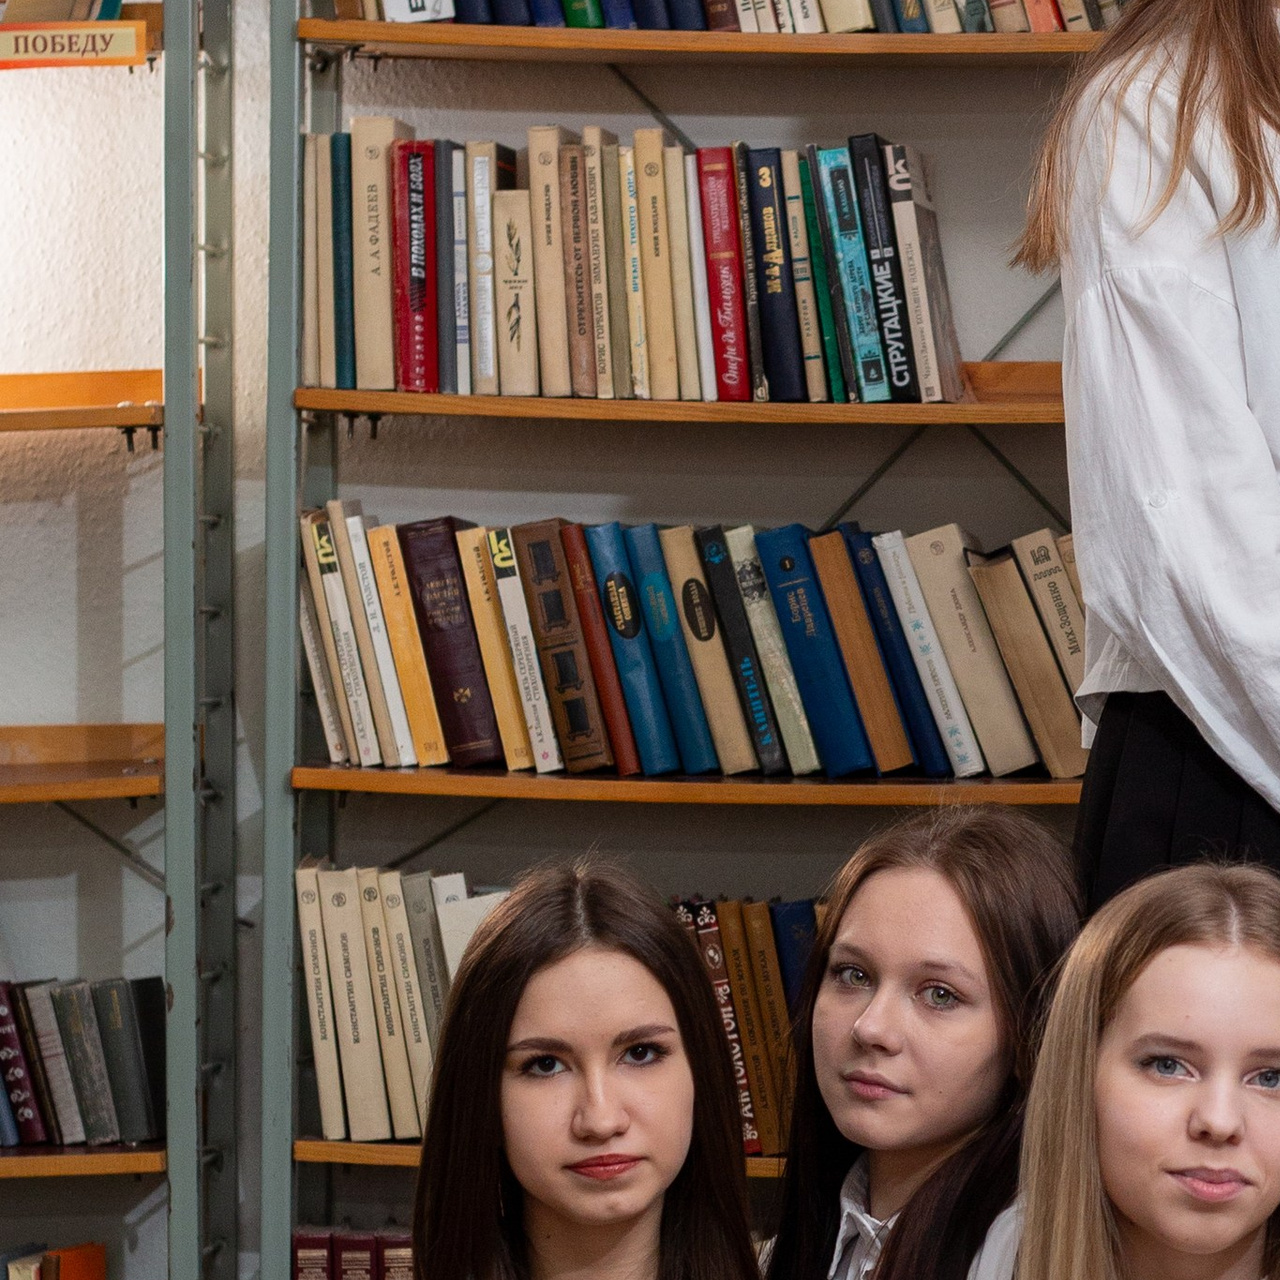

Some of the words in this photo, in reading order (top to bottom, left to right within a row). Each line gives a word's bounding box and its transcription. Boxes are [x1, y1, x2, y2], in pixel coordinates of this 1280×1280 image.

[13, 34, 116, 58] ПОБЕДУ
[408, 156, 422, 189] БОЯХ
[739, 171, 749, 210] обезьян
[758, 167, 771, 187] 3
[366, 184, 380, 245] ФАДЕЕВ
[588, 166, 600, 223] КАЗАКЕВИЧ
[409, 207, 423, 265] ПОХОДАХ
[571, 200, 582, 243] ПЕРВОЙ
[629, 206, 637, 244] ТИХОГО
[741, 213, 752, 255] племени
[411, 268, 424, 277] В
[573, 246, 583, 261] ОТ
[630, 257, 638, 292] ВРЕМЯ
[744, 257, 753, 269] из
[905, 242, 918, 283] НАДЕЖДЫ
[714, 265, 735, 327] Бальзак
[745, 272, 756, 305] Тарзан
[594, 293, 605, 340] ГОРБАТОВ
[724, 330, 734, 342] де
[873, 261, 911, 386] СТРУГАЦКИЕ
[597, 344, 607, 374] БОРИС
[720, 345, 742, 385] Оноре
[358, 562, 374, 606] ТОЛСТОЙ
[520, 635, 541, 701] СТИХОТВОРЕНИЯ
[309, 929, 320, 975] СИМОНОВ
[340, 932, 352, 978] СИМОНОВ
[372, 927, 385, 972] СИМОНОВ
[396, 932, 410, 978] СИМОНОВ
[315, 978, 328, 1040] КОНСТАНТИН
[346, 981, 360, 1044] КОНСТАНТИН
[380, 974, 395, 1037] КОНСТАНТИН
[404, 981, 421, 1043] КОНСТАНТИН
